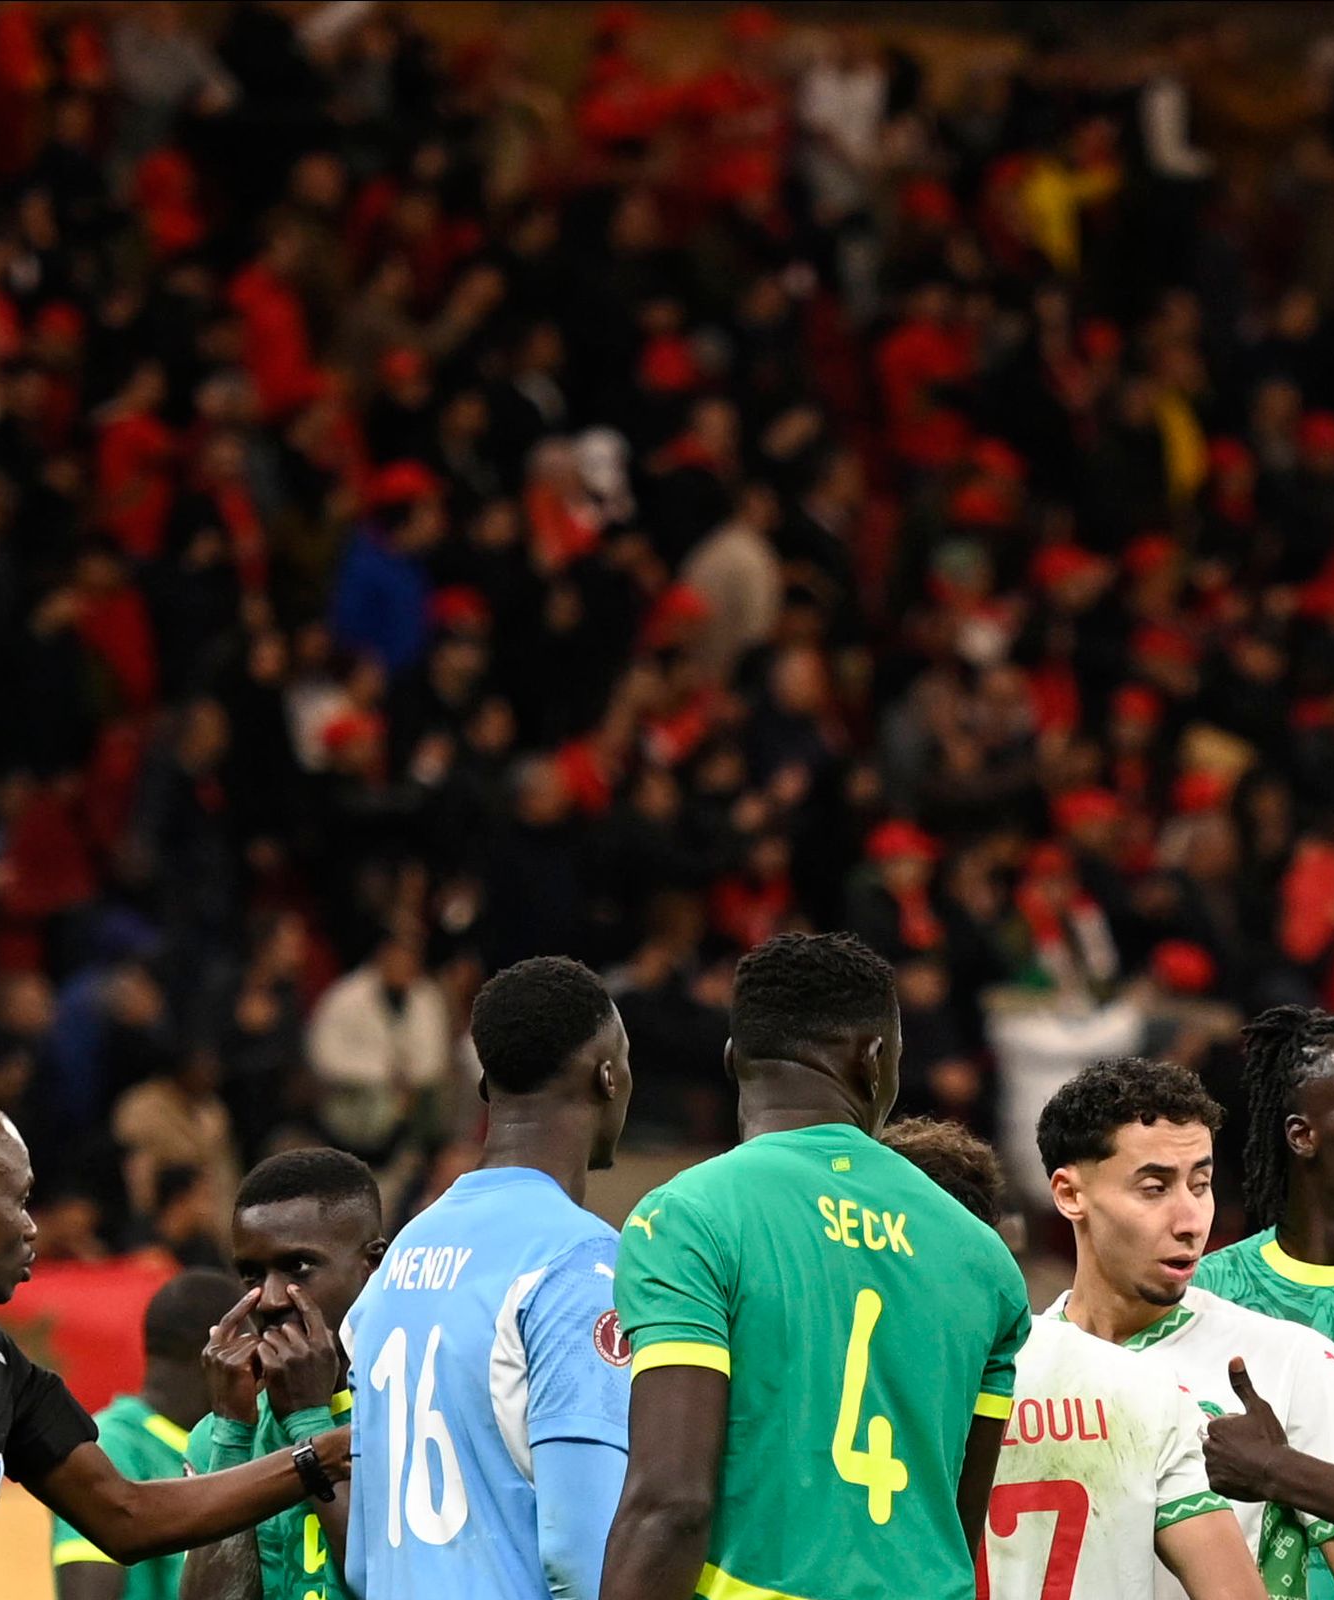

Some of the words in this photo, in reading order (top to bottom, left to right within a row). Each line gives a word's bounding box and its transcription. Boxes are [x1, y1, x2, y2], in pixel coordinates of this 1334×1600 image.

[382, 1246, 473, 1291] MENDY
[817, 1195, 914, 1257] SECK
[370, 1323, 470, 1548] 16
[831, 1288, 909, 1526] 4
